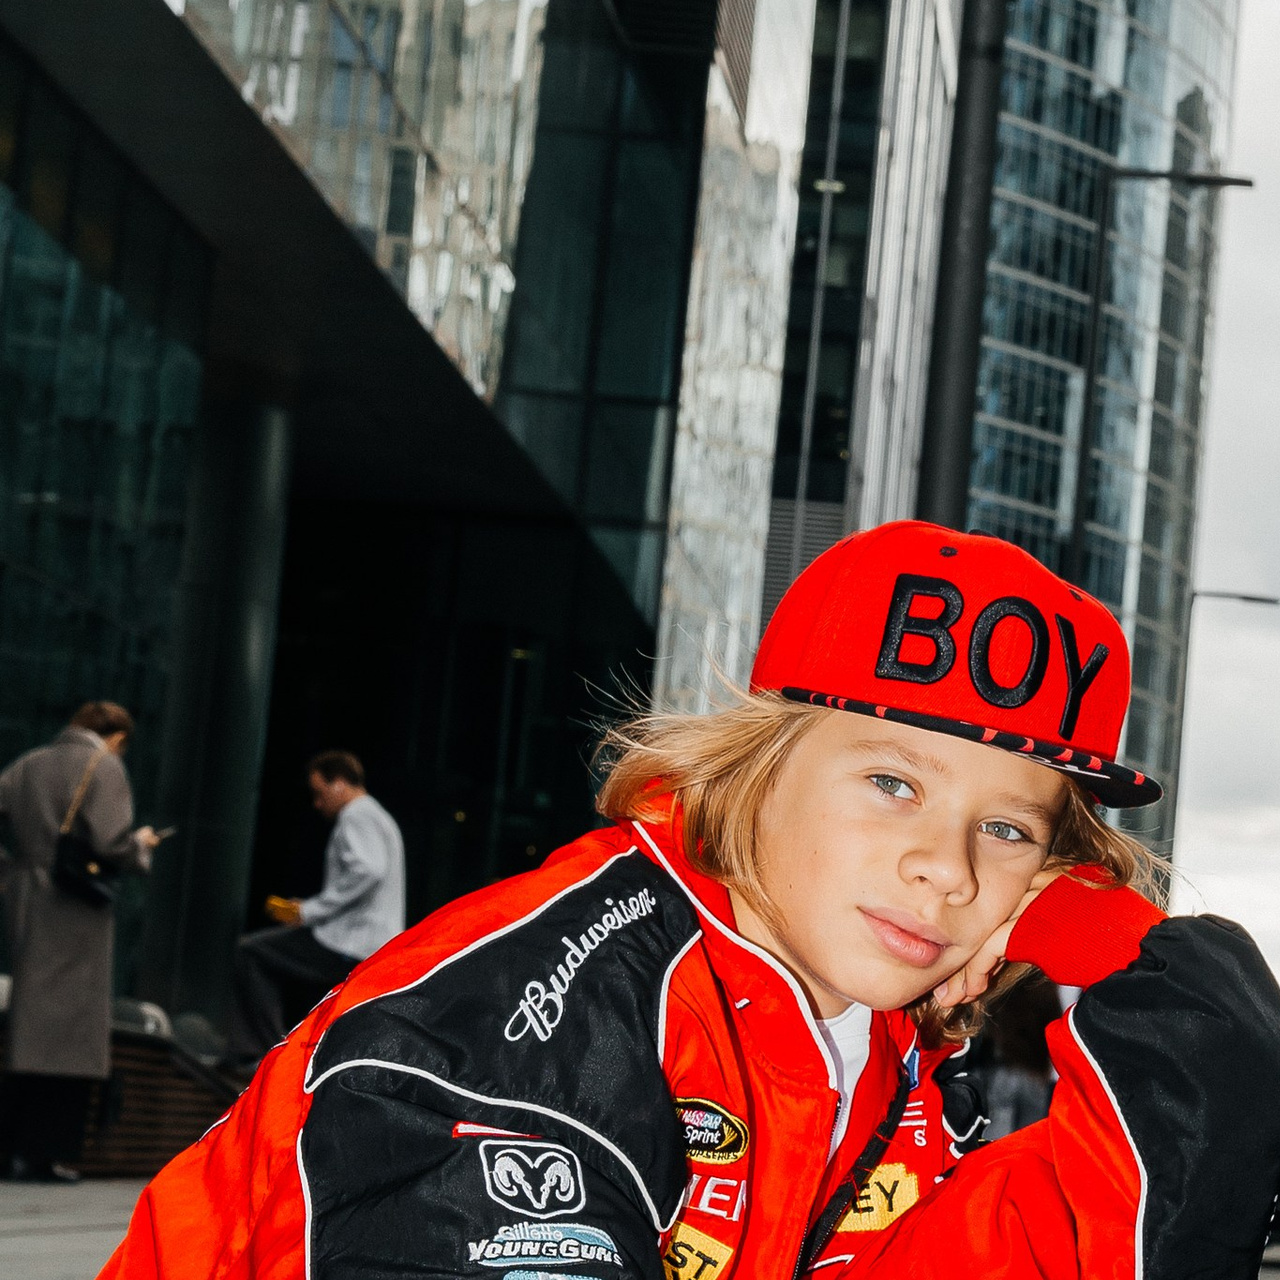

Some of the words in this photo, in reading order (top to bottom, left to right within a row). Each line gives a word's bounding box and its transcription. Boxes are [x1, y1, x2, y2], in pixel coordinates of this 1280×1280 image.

[875, 573, 1110, 741] BOY
[504, 888, 656, 1041] Budweiser
[683, 1125, 721, 1144] Sprint
[496, 1222, 564, 1241] Gillette
